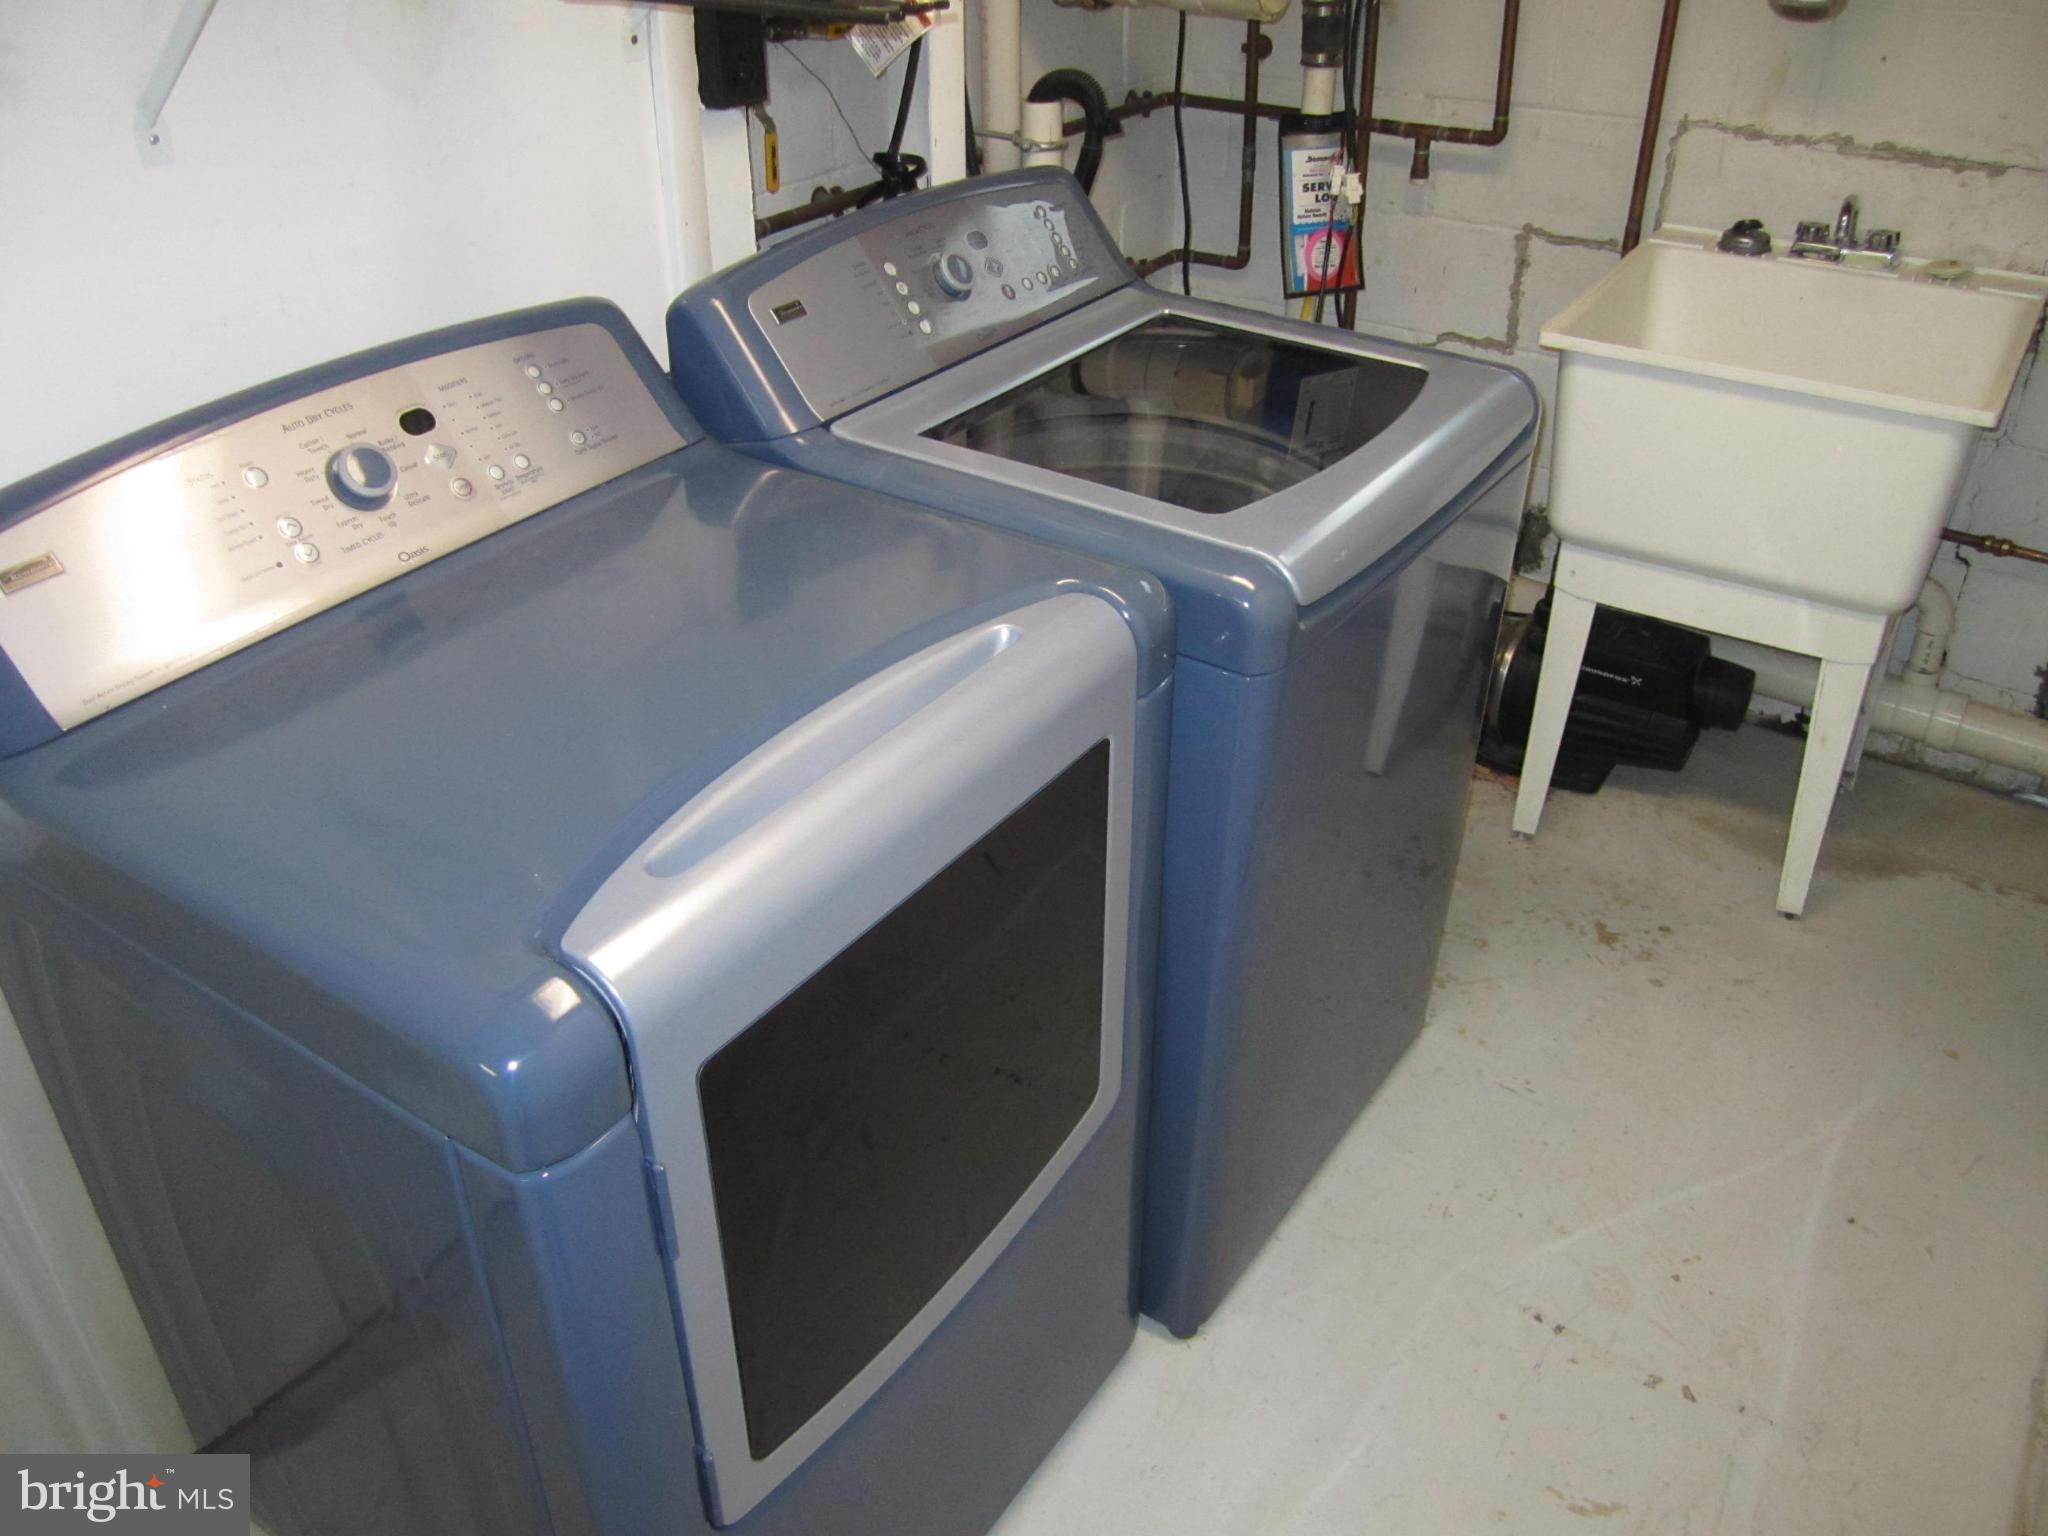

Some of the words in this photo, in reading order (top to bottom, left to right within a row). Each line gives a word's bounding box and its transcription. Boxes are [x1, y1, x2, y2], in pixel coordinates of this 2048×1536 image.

[281, 420, 305, 433] AUTO
[324, 402, 354, 417] CYCLES
[398, 545, 430, 562] Oasis
